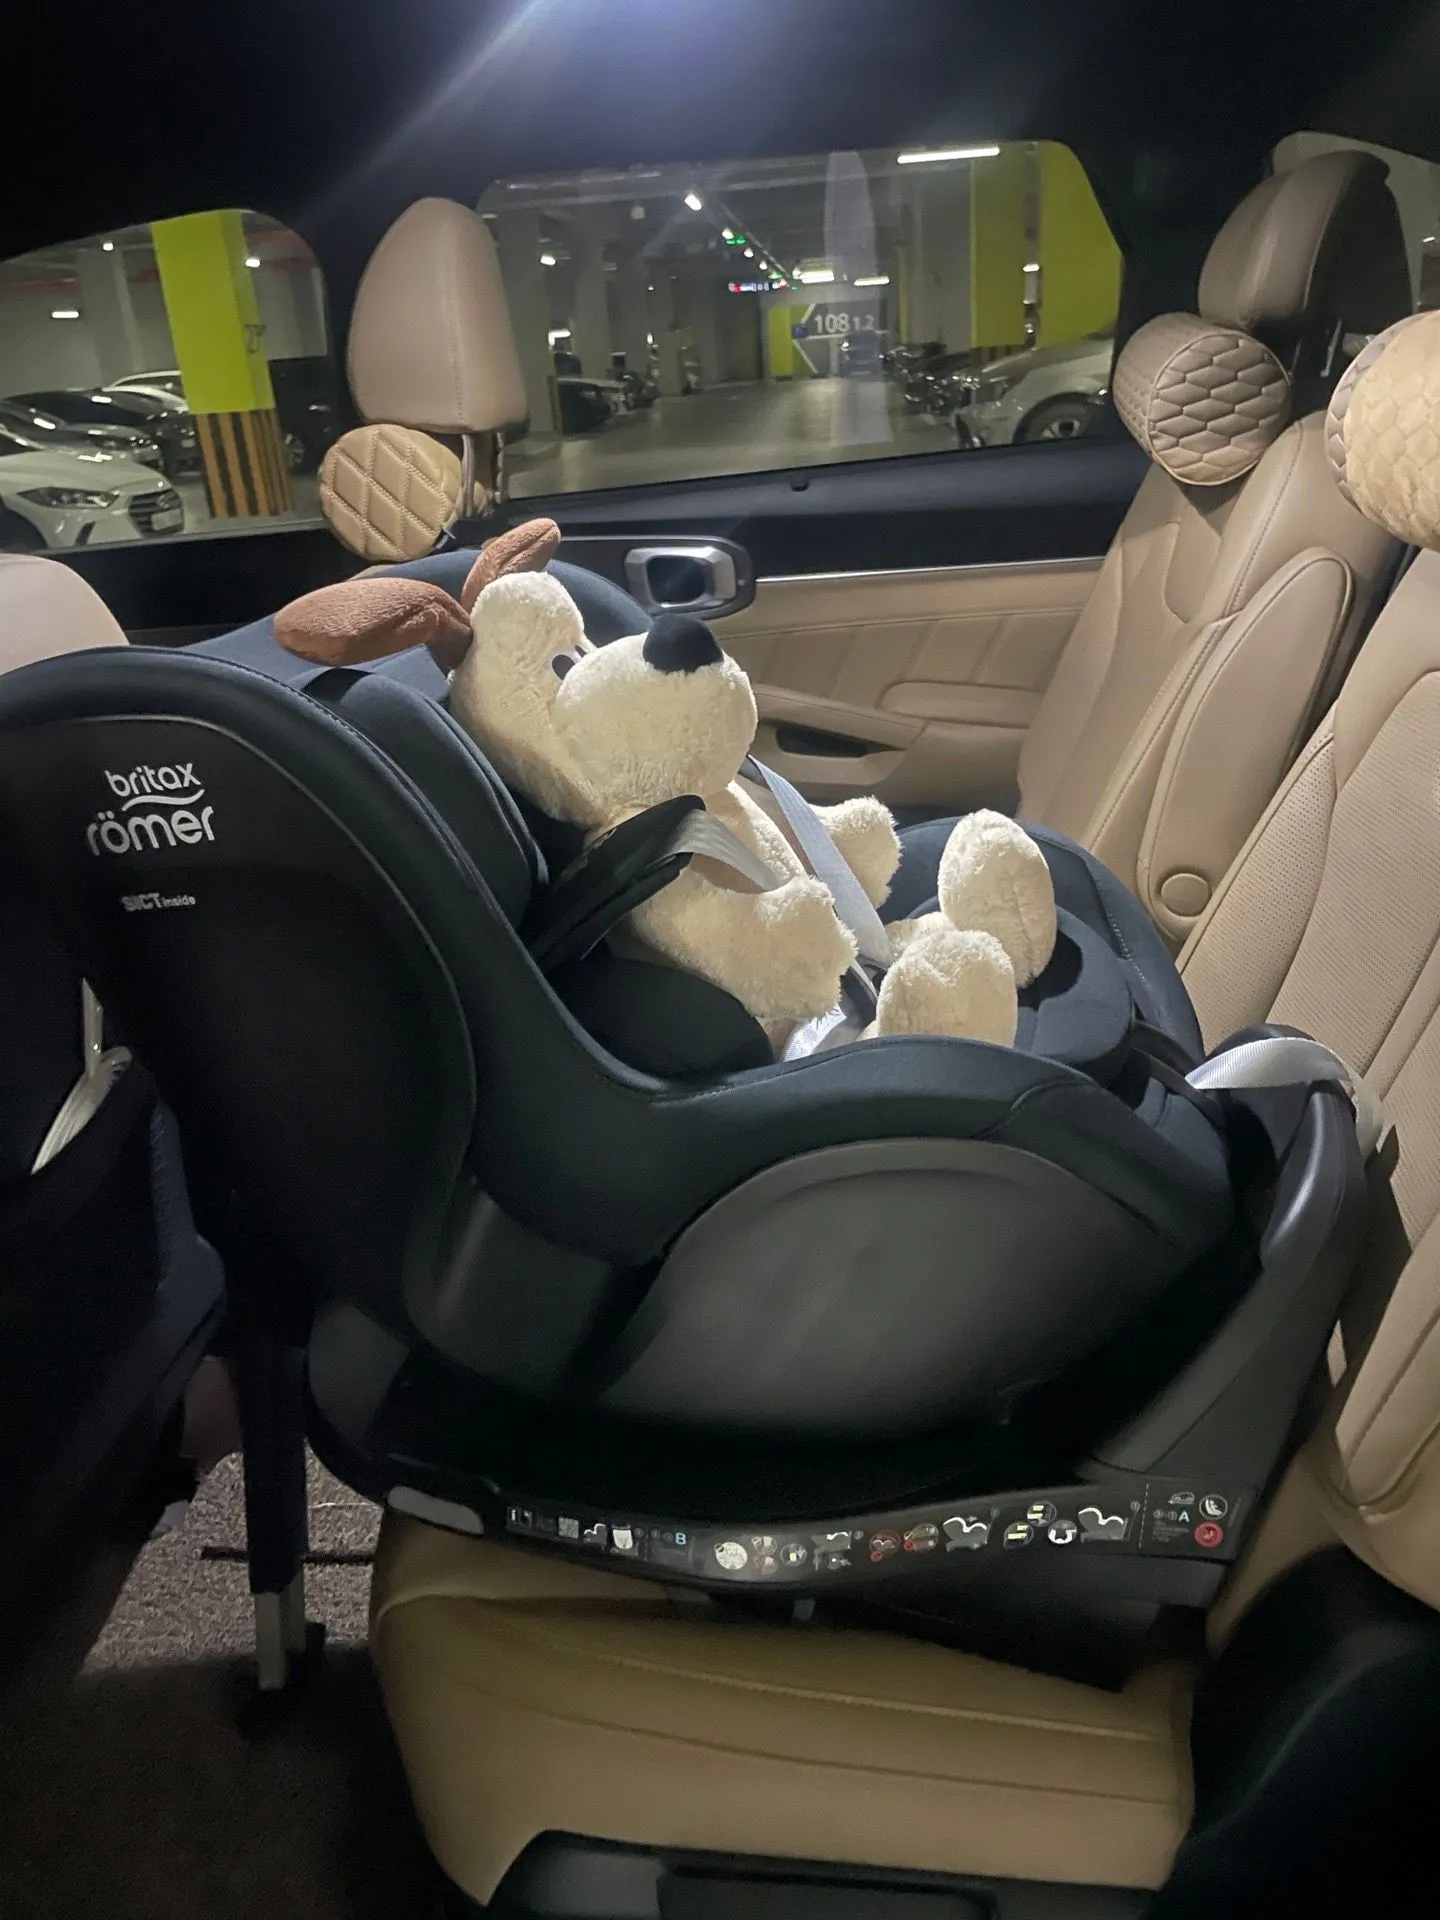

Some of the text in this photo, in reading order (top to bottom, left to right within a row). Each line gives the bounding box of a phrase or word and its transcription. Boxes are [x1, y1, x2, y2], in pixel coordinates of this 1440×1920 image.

[814, 312, 850, 333] 108
[104, 763, 202, 797] britax
[87, 806, 216, 856] römer
[1178, 1510, 1190, 1523] A
[675, 1532, 687, 1545] B
